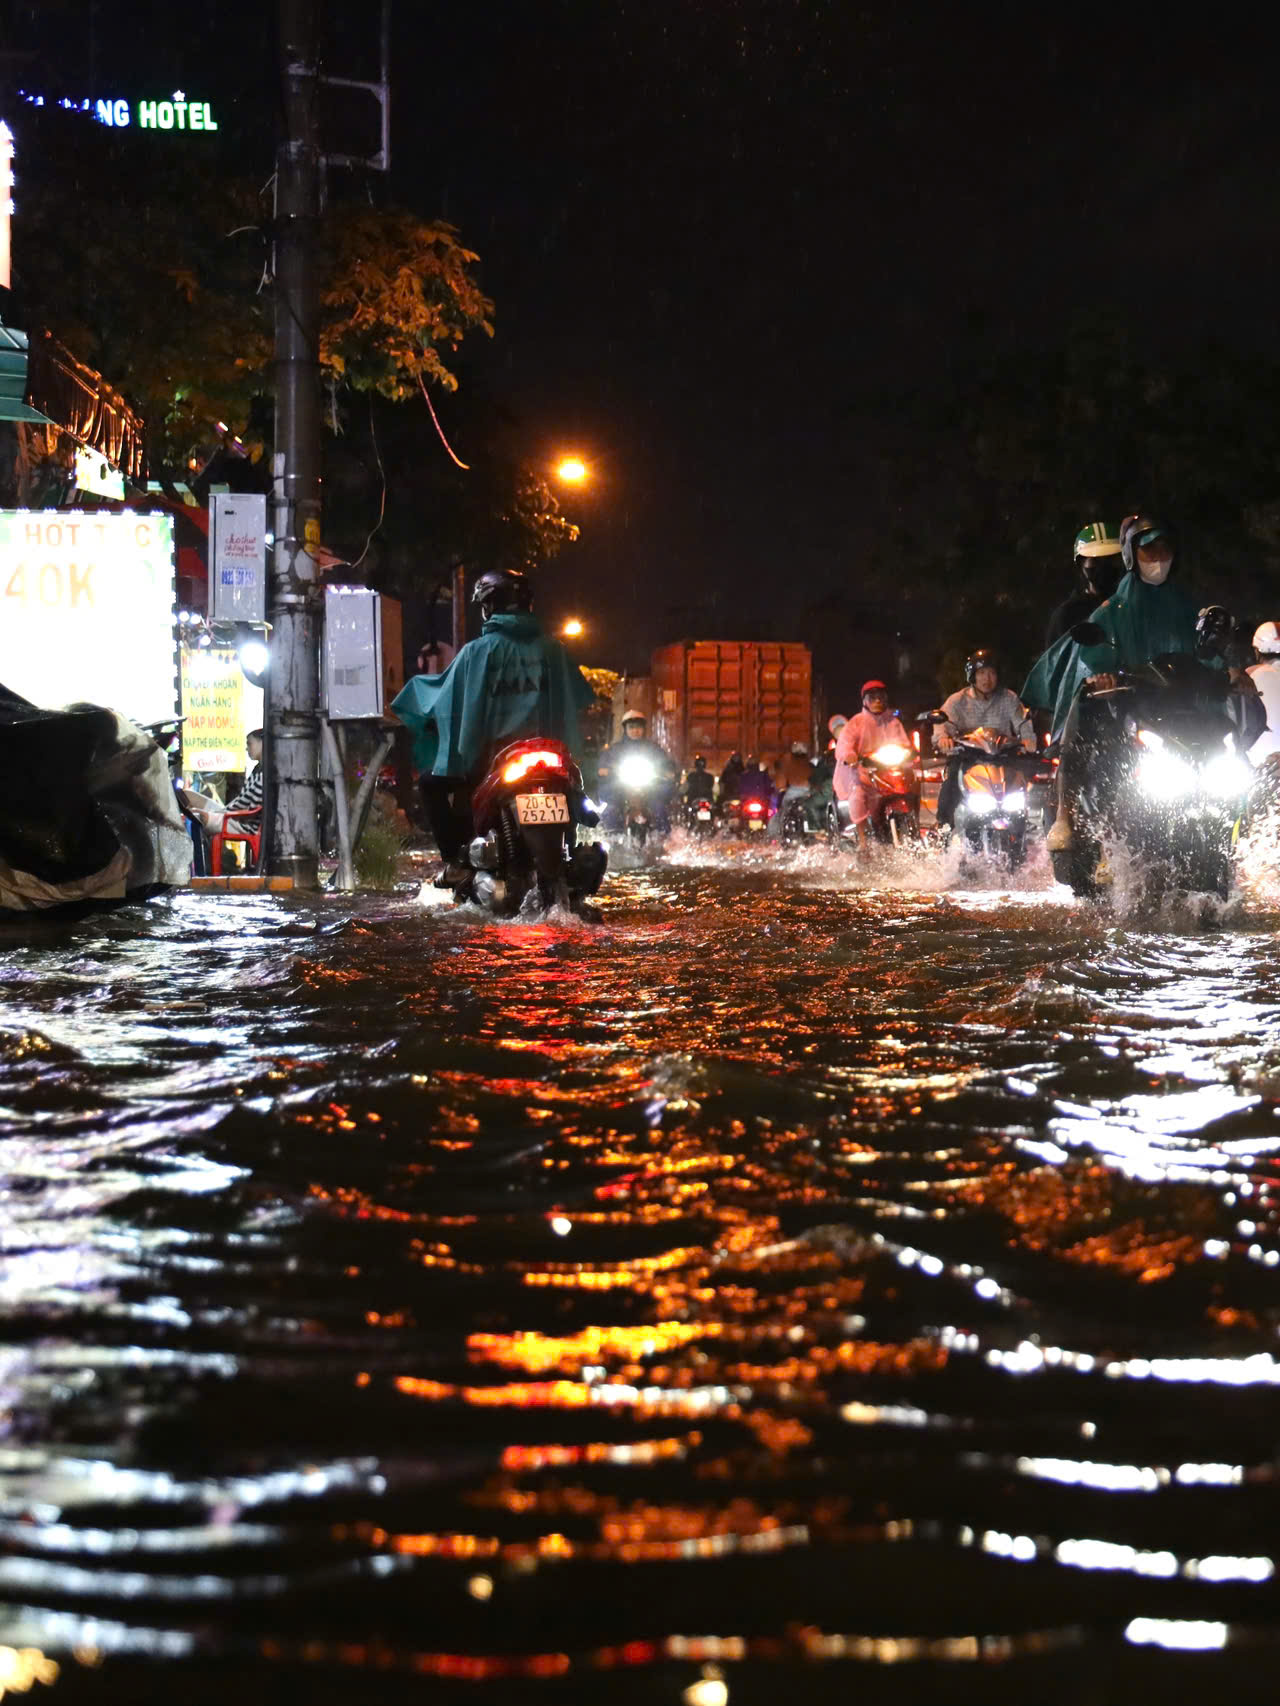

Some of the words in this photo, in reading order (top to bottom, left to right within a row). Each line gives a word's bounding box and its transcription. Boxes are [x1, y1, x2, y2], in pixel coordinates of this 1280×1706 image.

[139, 100, 218, 130] HOTEL
[5, 562, 96, 609] 40K
[522, 809, 564, 822] 252.17
